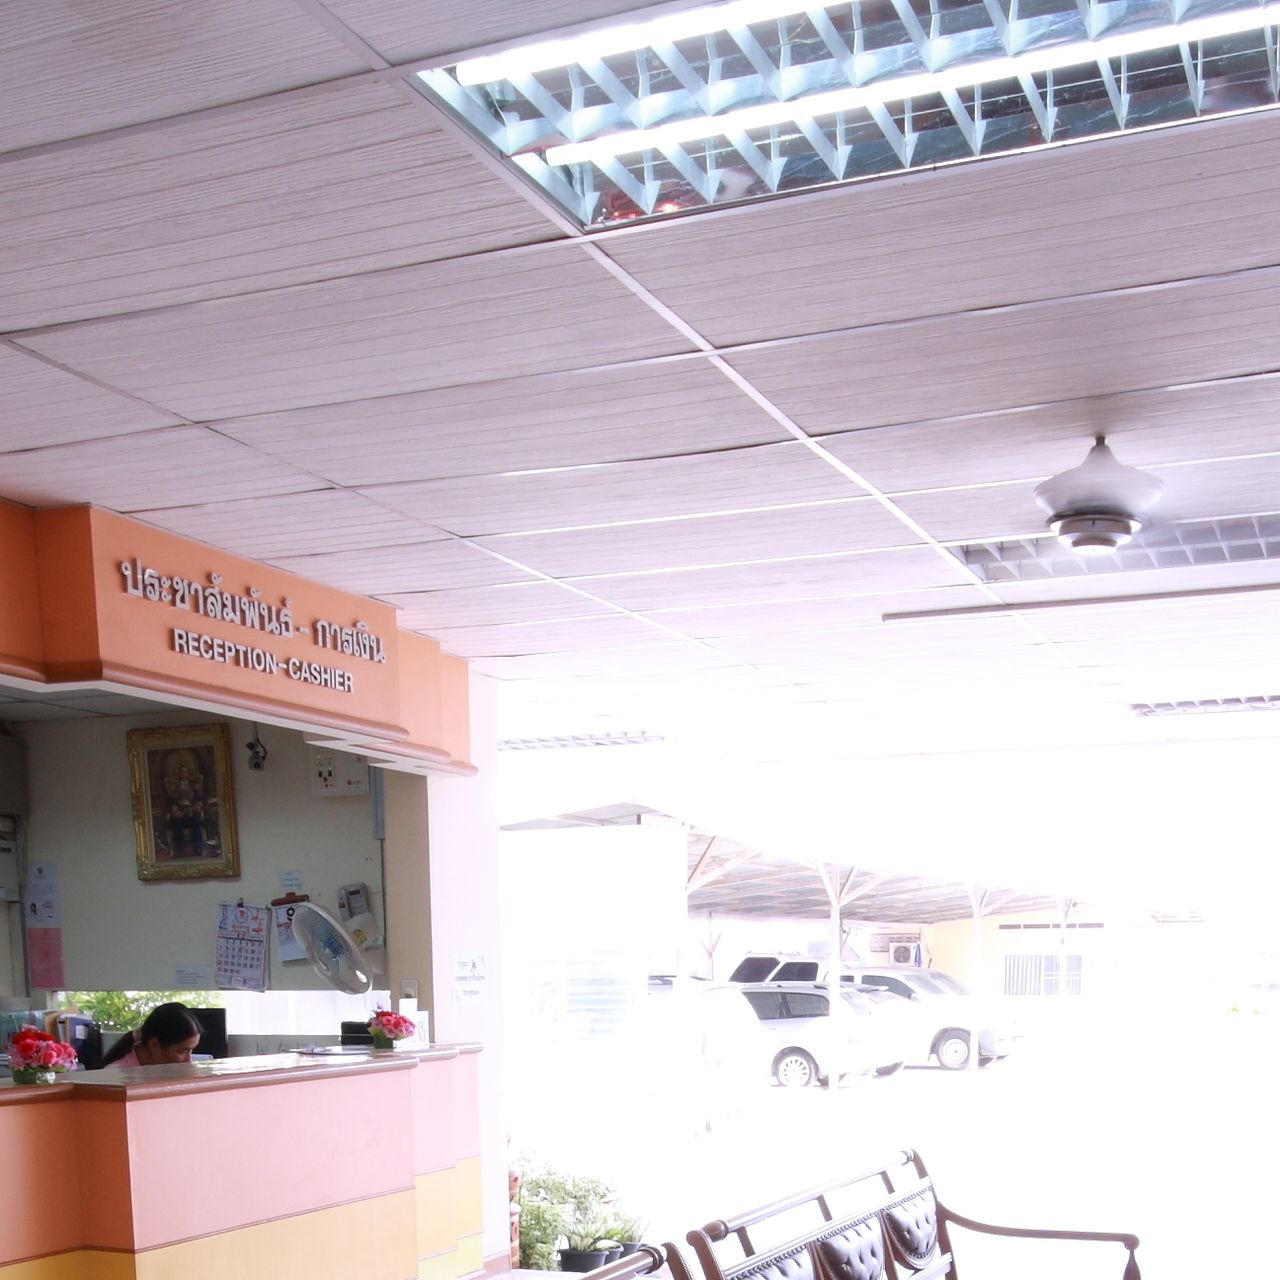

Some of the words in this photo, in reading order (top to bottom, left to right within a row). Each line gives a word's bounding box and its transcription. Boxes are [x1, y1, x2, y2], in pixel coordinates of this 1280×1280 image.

[119, 557, 294, 640] ประชาสัมพันธ์
[314, 616, 388, 664] การเงิน
